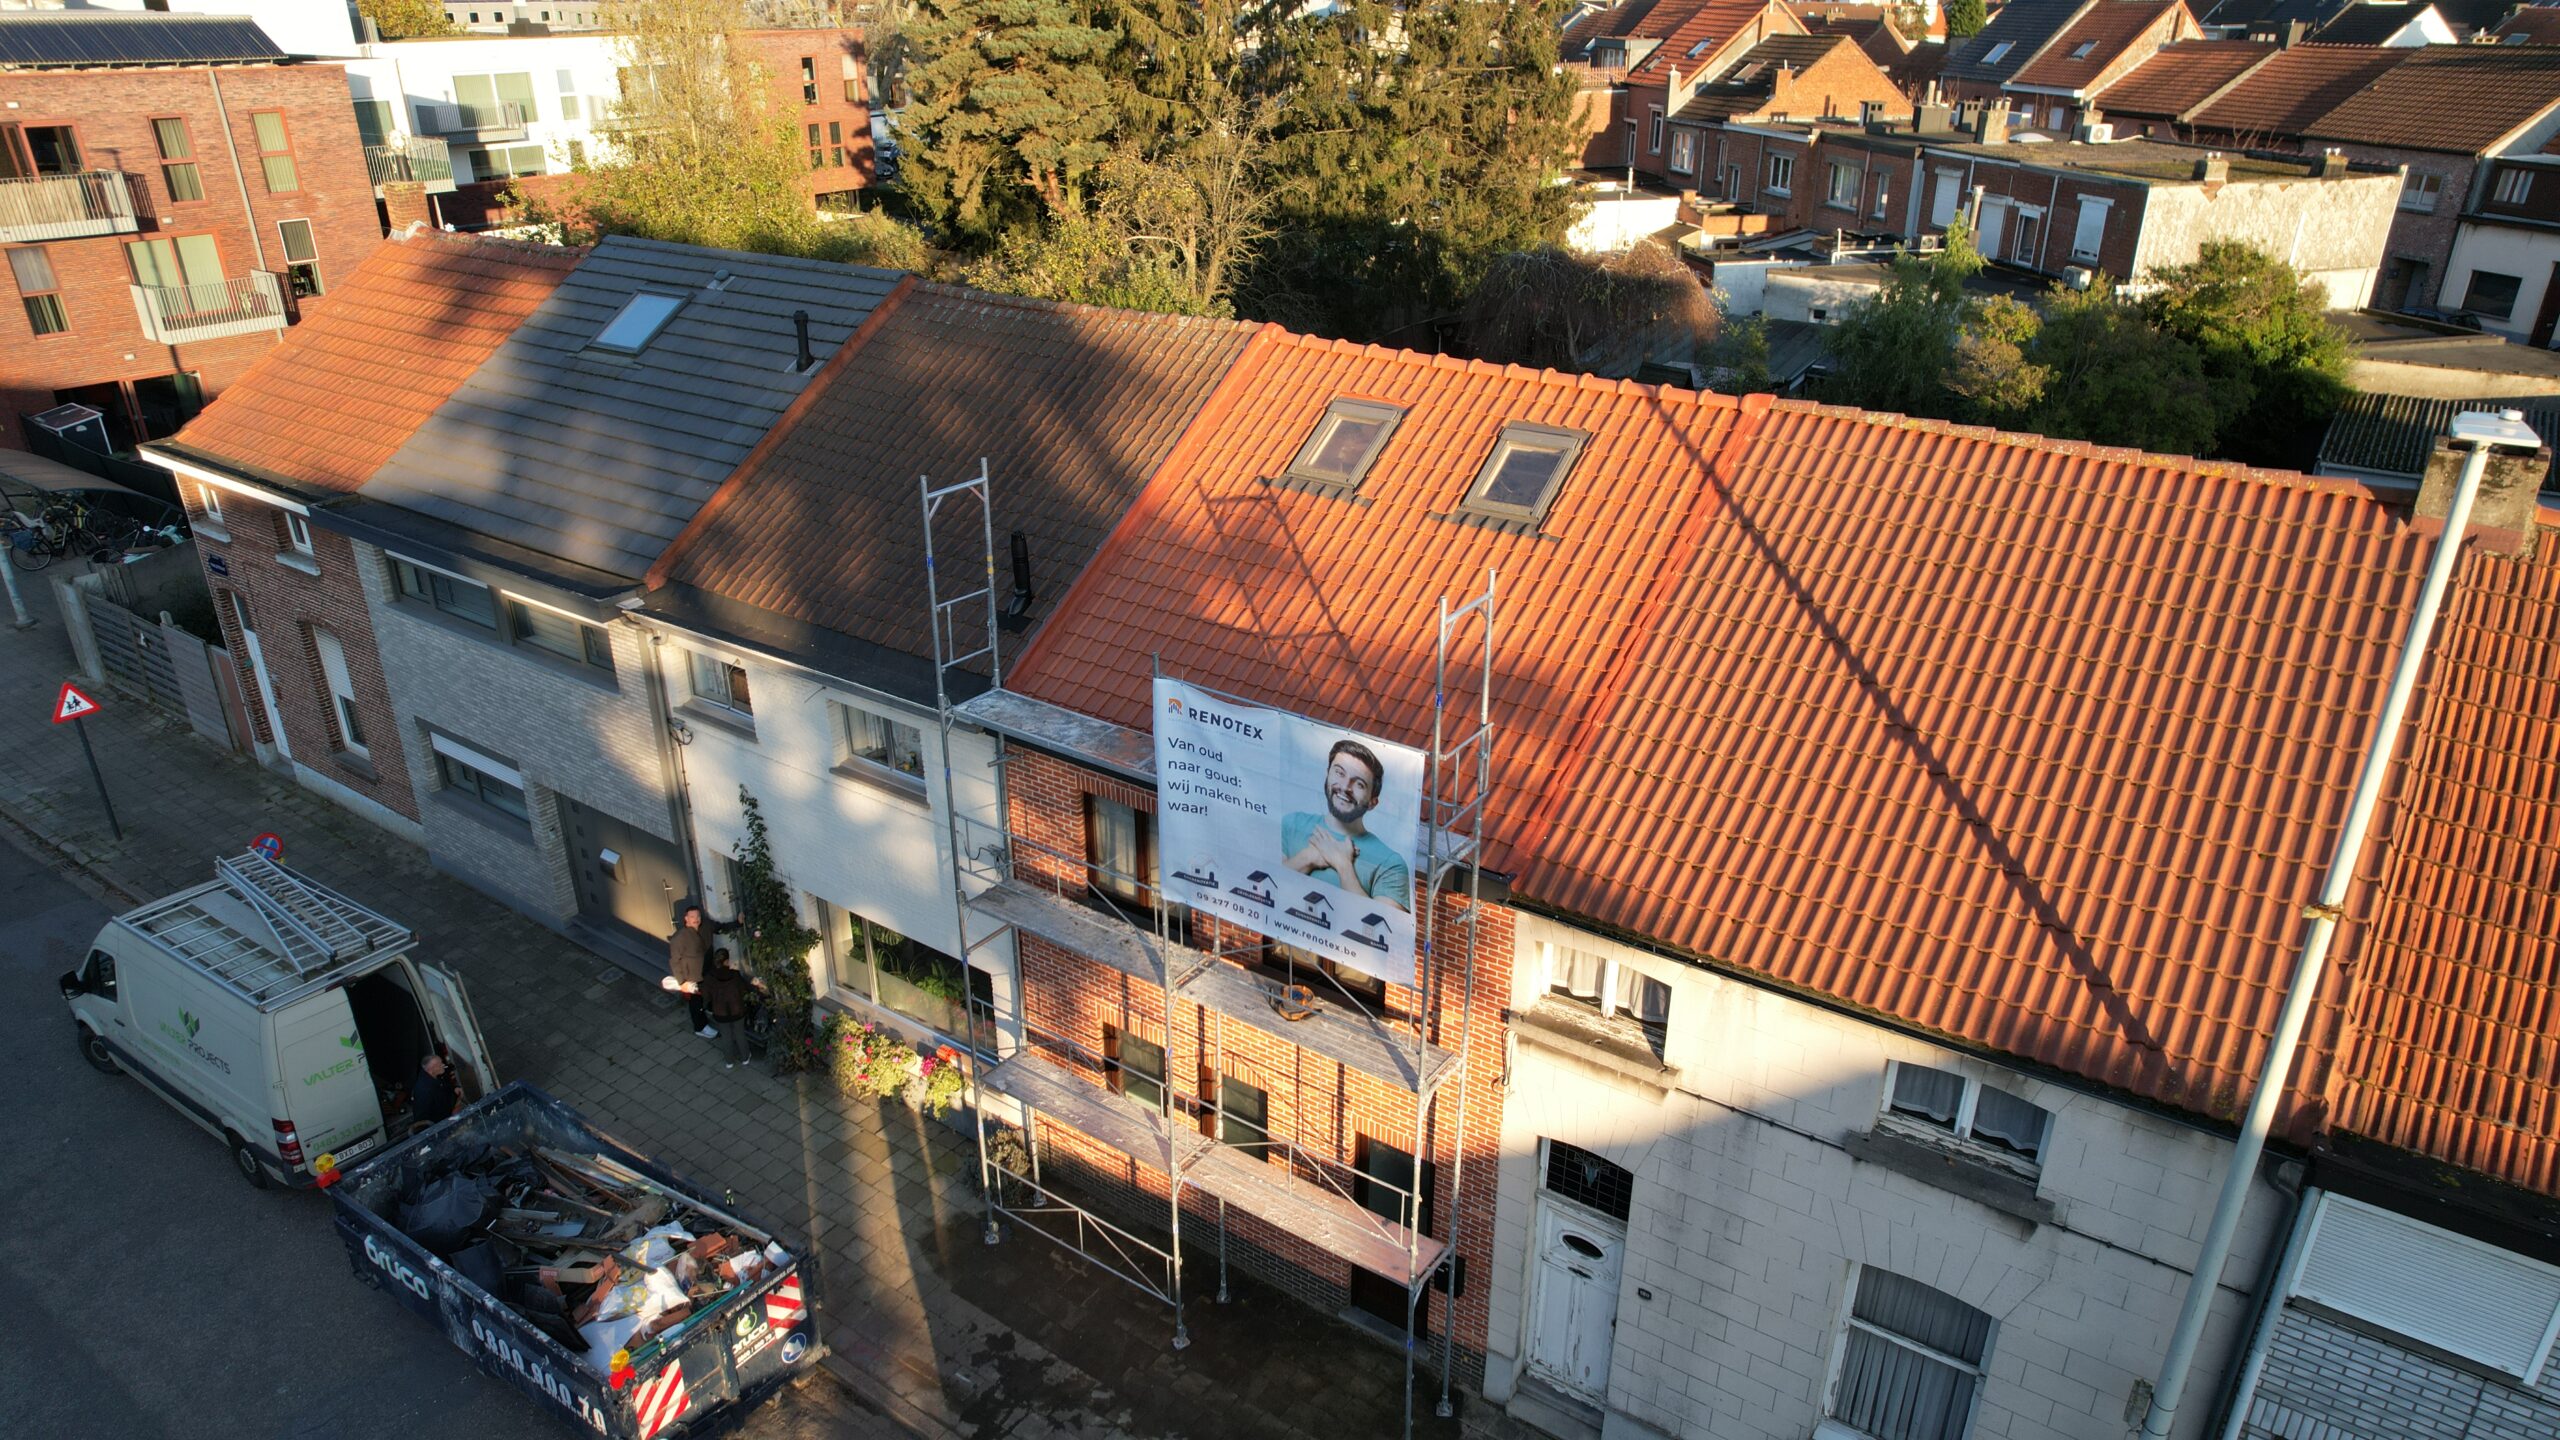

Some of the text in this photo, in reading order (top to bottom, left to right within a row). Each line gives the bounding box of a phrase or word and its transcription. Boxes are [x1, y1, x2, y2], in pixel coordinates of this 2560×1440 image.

[1188, 707, 1263, 740] RENOTEX
[1168, 737, 1223, 762] Van oud
[1168, 760, 1242, 788] naar goud:
[1168, 780, 1268, 815] wij maken het
[1168, 801, 1208, 816] waar!
[1197, 892, 1209, 901] 09
[1212, 897, 1229, 908] 277
[1232, 903, 1244, 913] 08
[1248, 909, 1260, 919] 20
[1274, 920, 1357, 958] www.renotex.be
[188, 1039, 231, 1075] PROJECTS
[303, 1059, 353, 1086] VALTER
[364, 1234, 430, 1300] bruco
[472, 1319, 525, 1374] 0800
